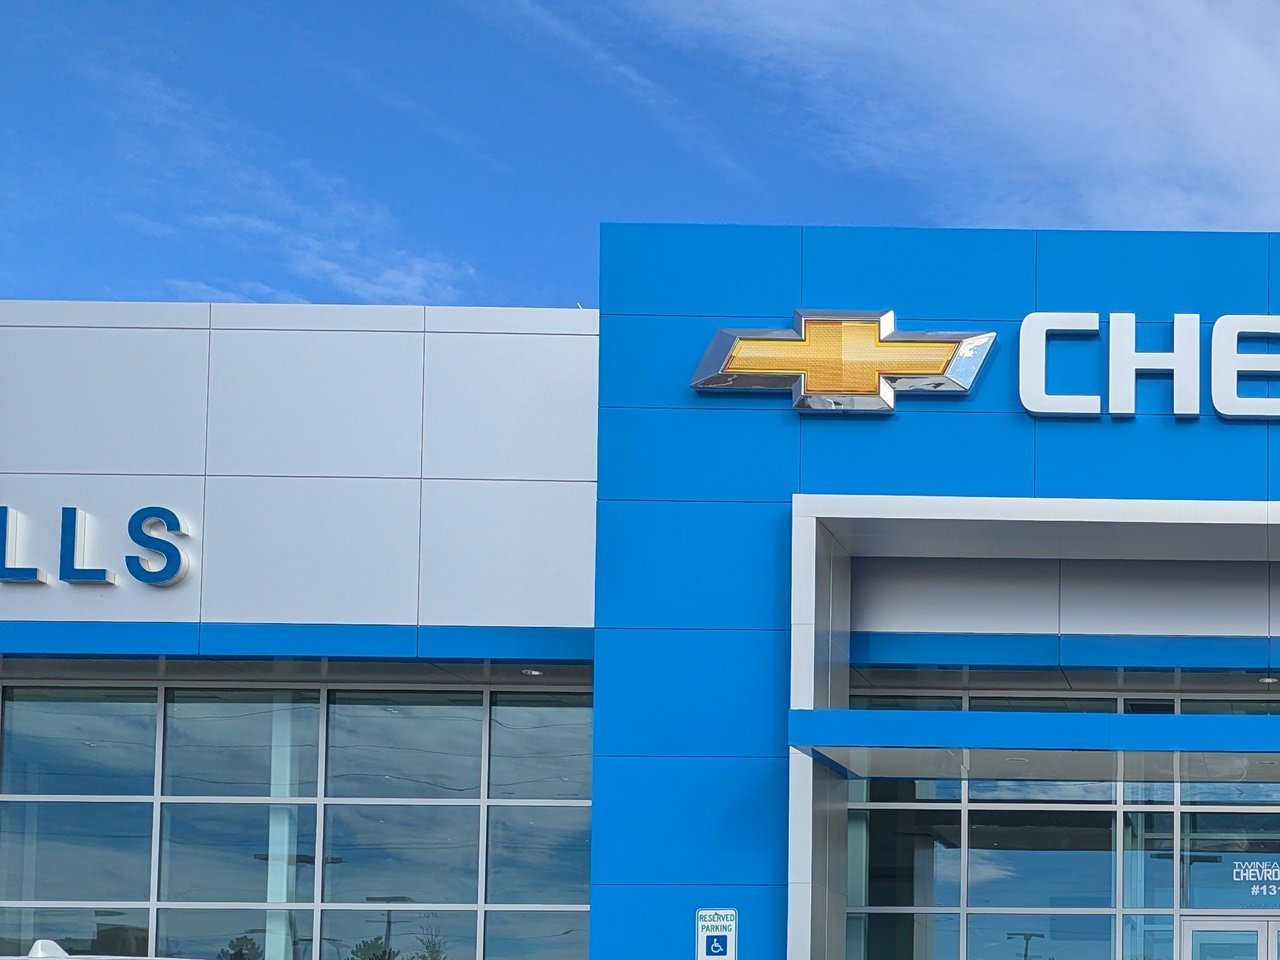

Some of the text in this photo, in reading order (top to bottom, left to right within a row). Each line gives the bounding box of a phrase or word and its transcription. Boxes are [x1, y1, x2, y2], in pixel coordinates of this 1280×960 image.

[0, 505, 190, 587] LLS
[699, 914, 735, 922] RESERVED
[701, 924, 732, 933] PARKING
